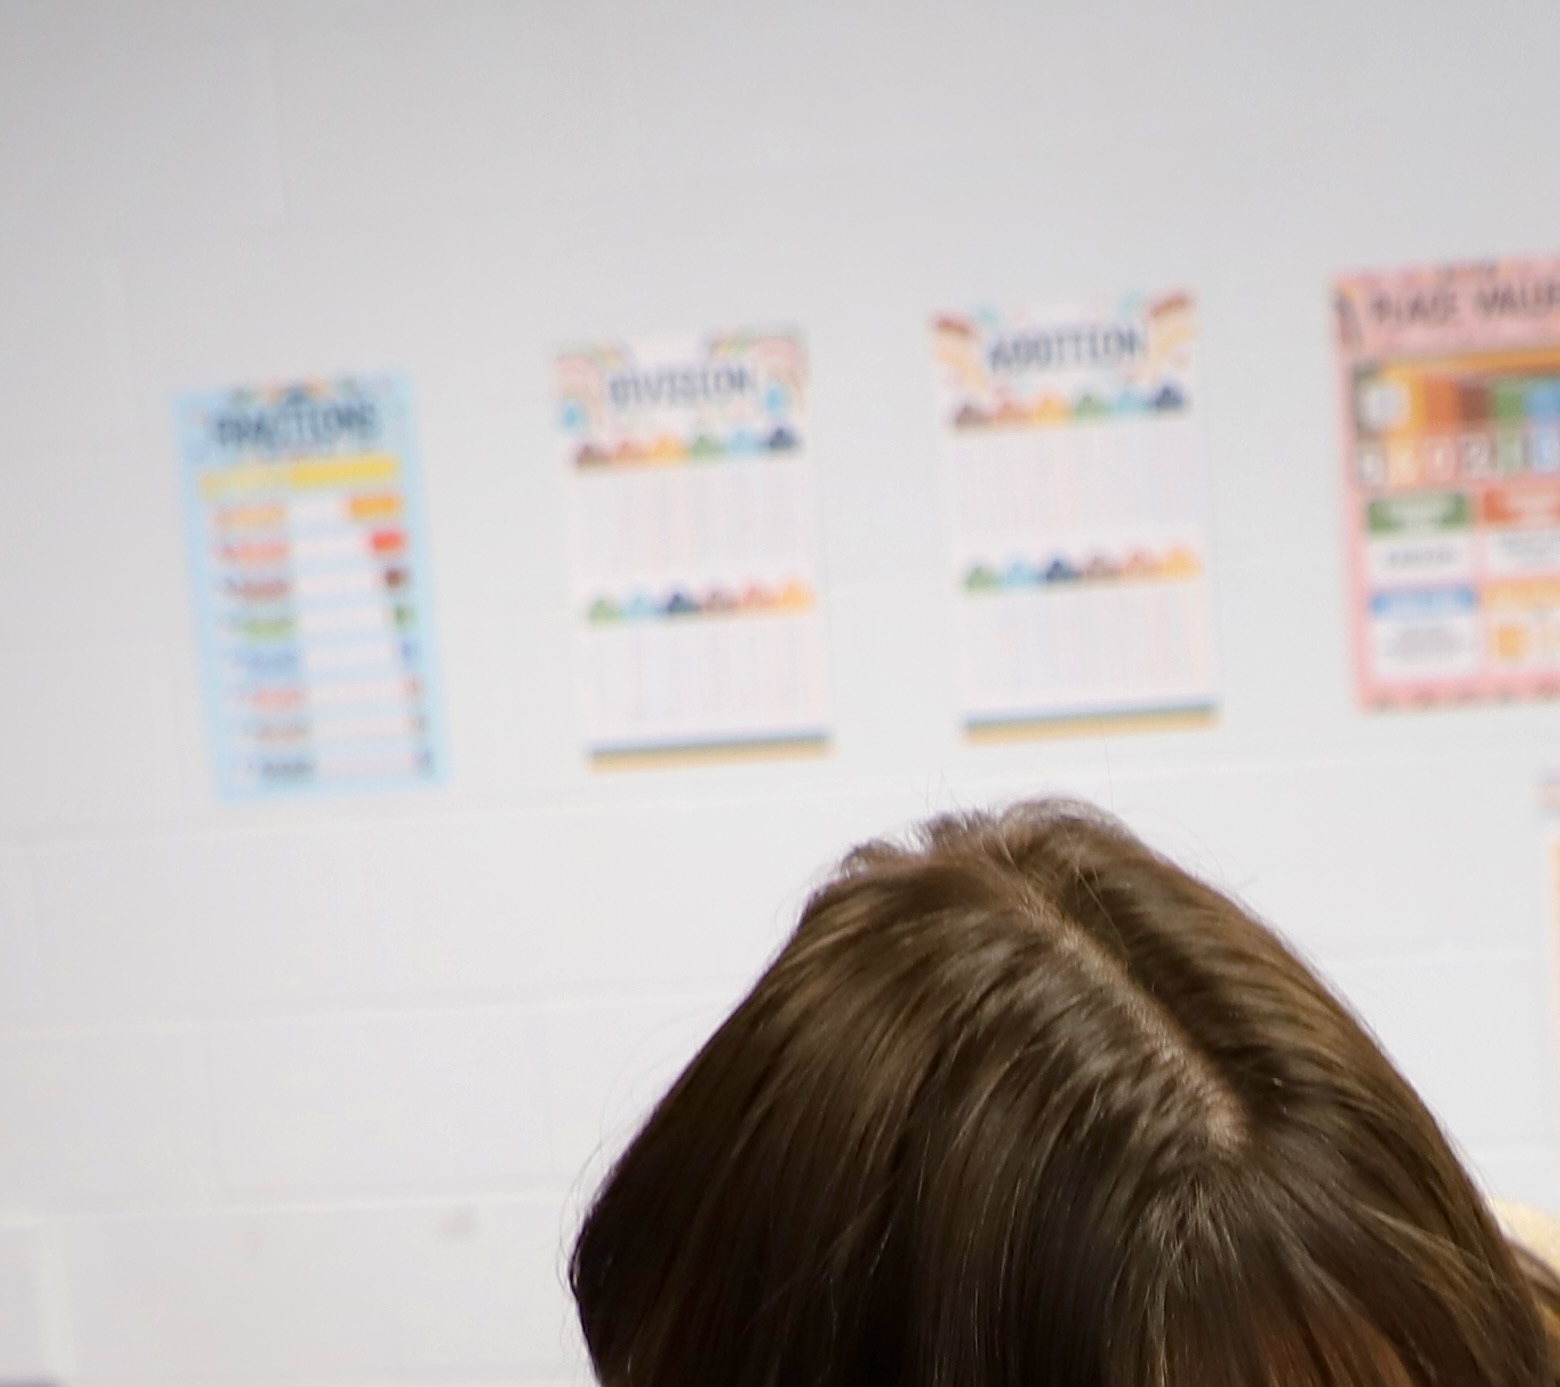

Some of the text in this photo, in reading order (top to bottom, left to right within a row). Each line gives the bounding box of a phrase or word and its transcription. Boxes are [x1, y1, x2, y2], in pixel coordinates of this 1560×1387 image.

[1371, 290, 1458, 325] PLACE
[989, 325, 1149, 373] ADDITION
[608, 366, 754, 407] DIVISION
[216, 403, 378, 448] FRACTIONS
